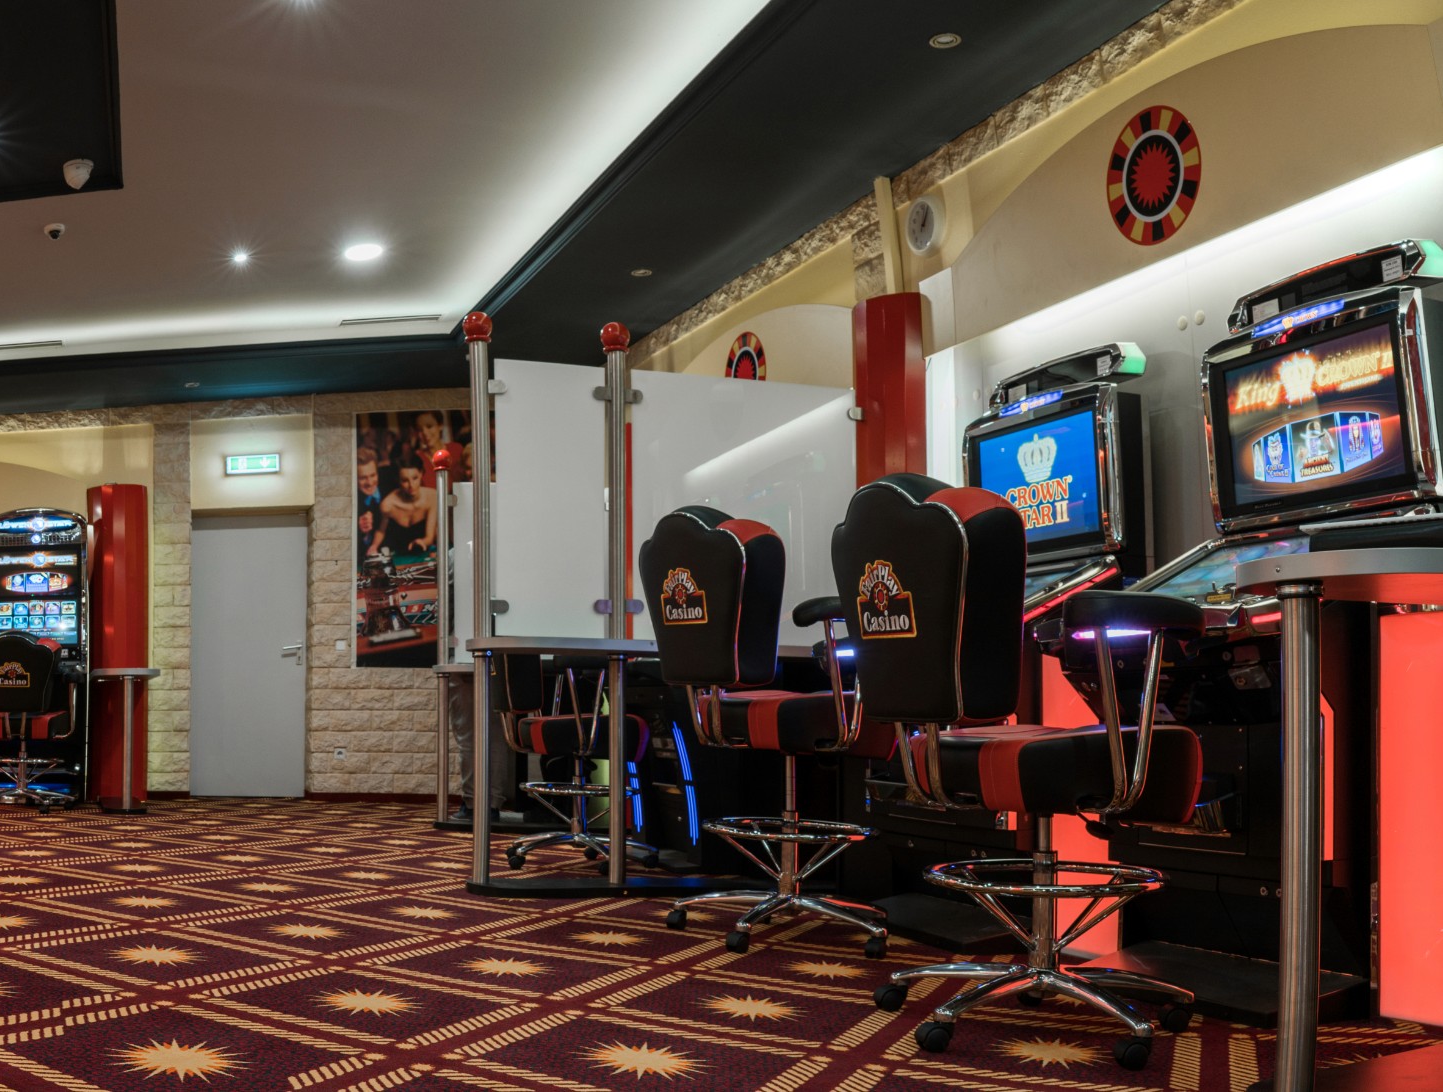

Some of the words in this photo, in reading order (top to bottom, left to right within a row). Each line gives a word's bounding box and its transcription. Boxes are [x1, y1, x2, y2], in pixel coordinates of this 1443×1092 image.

[1235, 381, 1281, 409] King
[1315, 352, 1380, 387] CROWN
[1006, 476, 1072, 507] CROWN
[1020, 504, 1053, 530] TAR
[1054, 500, 1070, 524] II
[665, 604, 703, 620] Casino
[863, 610, 910, 632] Casino
